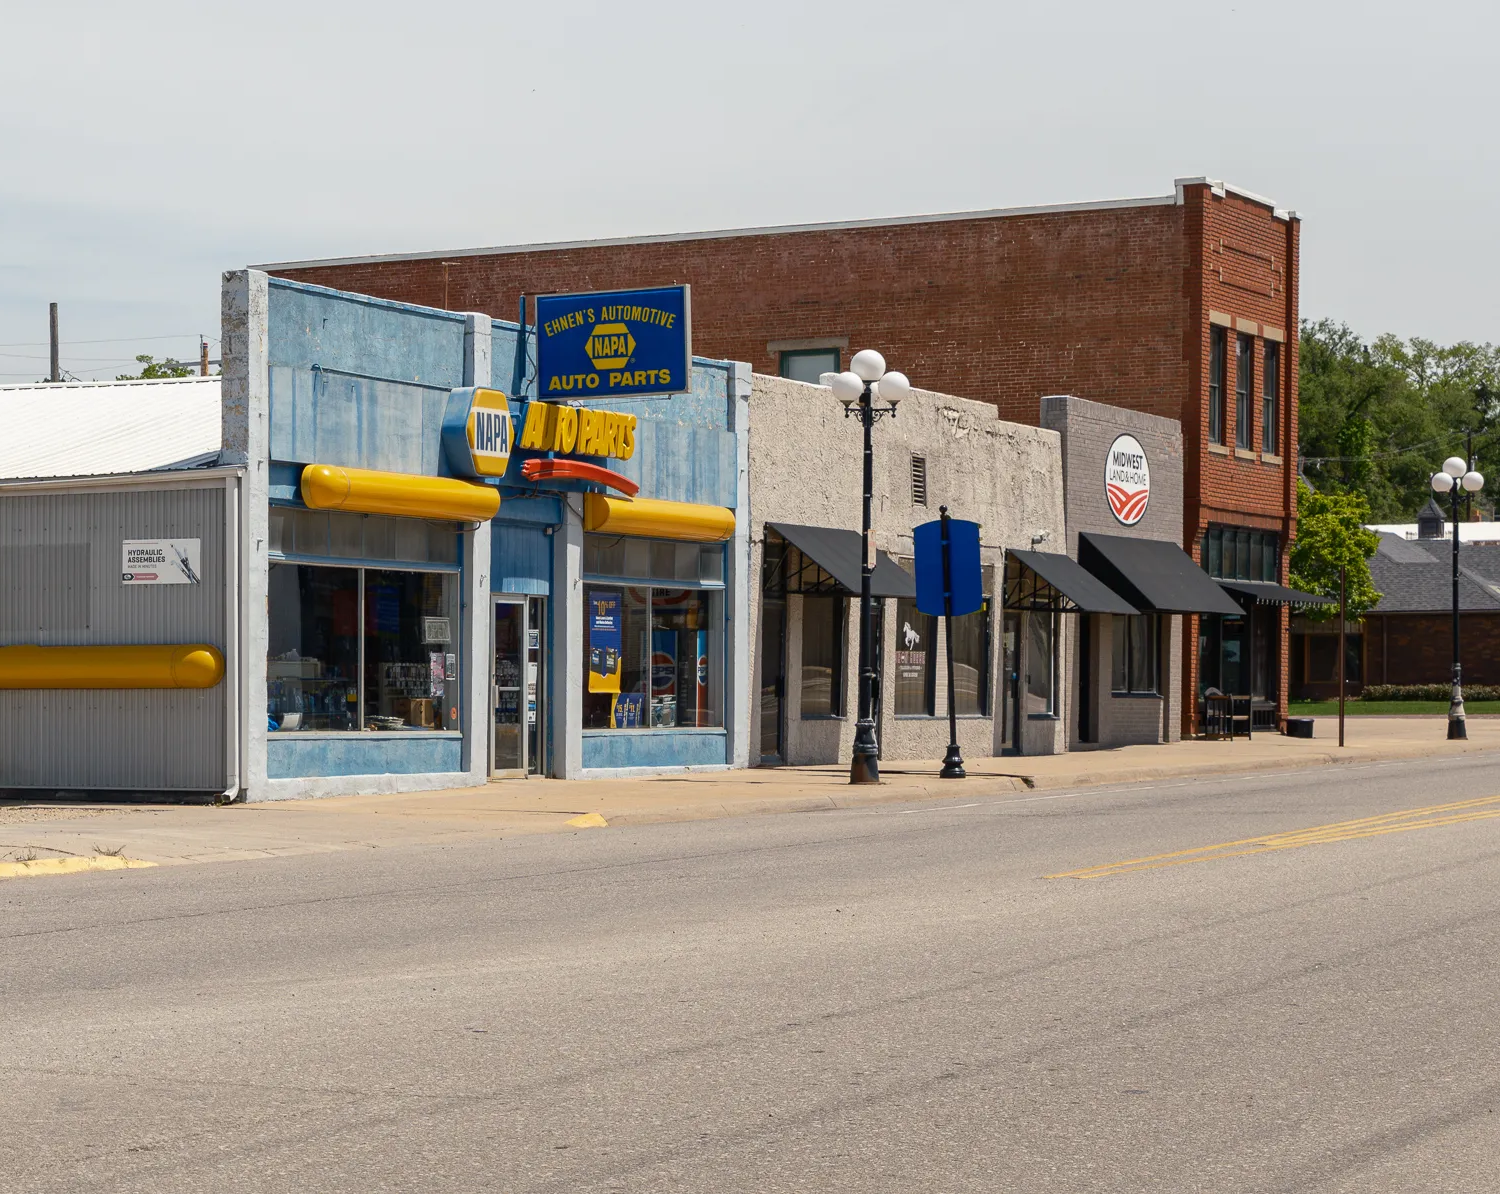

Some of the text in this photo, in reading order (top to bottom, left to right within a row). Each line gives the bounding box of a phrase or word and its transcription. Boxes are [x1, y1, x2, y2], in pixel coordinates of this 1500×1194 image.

[544, 305, 677, 337] EHNEN'S AUTOMOTIVE
[593, 335, 627, 357] NAPA
[548, 369, 671, 391] AUTO PARTS
[476, 411, 508, 453] NAPA
[519, 401, 637, 461] AUTO PARTS
[1113, 451, 1143, 470] MIDWEST
